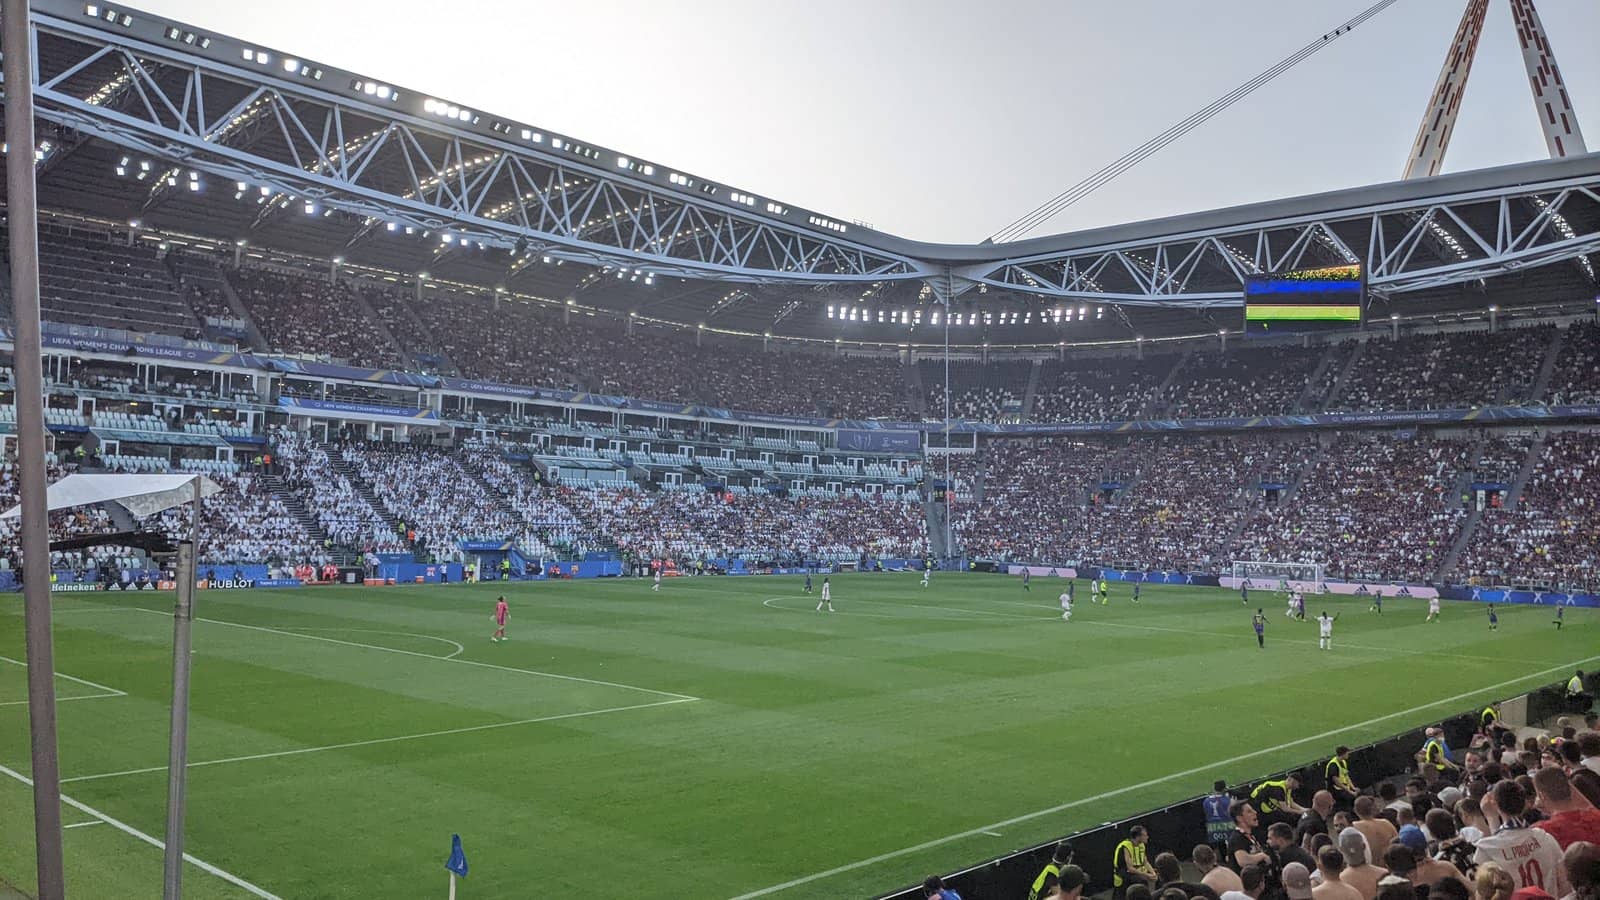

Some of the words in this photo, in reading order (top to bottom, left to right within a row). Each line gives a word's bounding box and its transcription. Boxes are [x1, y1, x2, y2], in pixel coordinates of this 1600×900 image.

[52, 337, 71, 345] UEFA
[109, 344, 154, 354] CHAIONS
[156, 349, 182, 357] LEAGUE
[51, 582, 96, 592] Heineken
[208, 579, 254, 589] HUBLOT
[1518, 858, 1545, 891] 10
